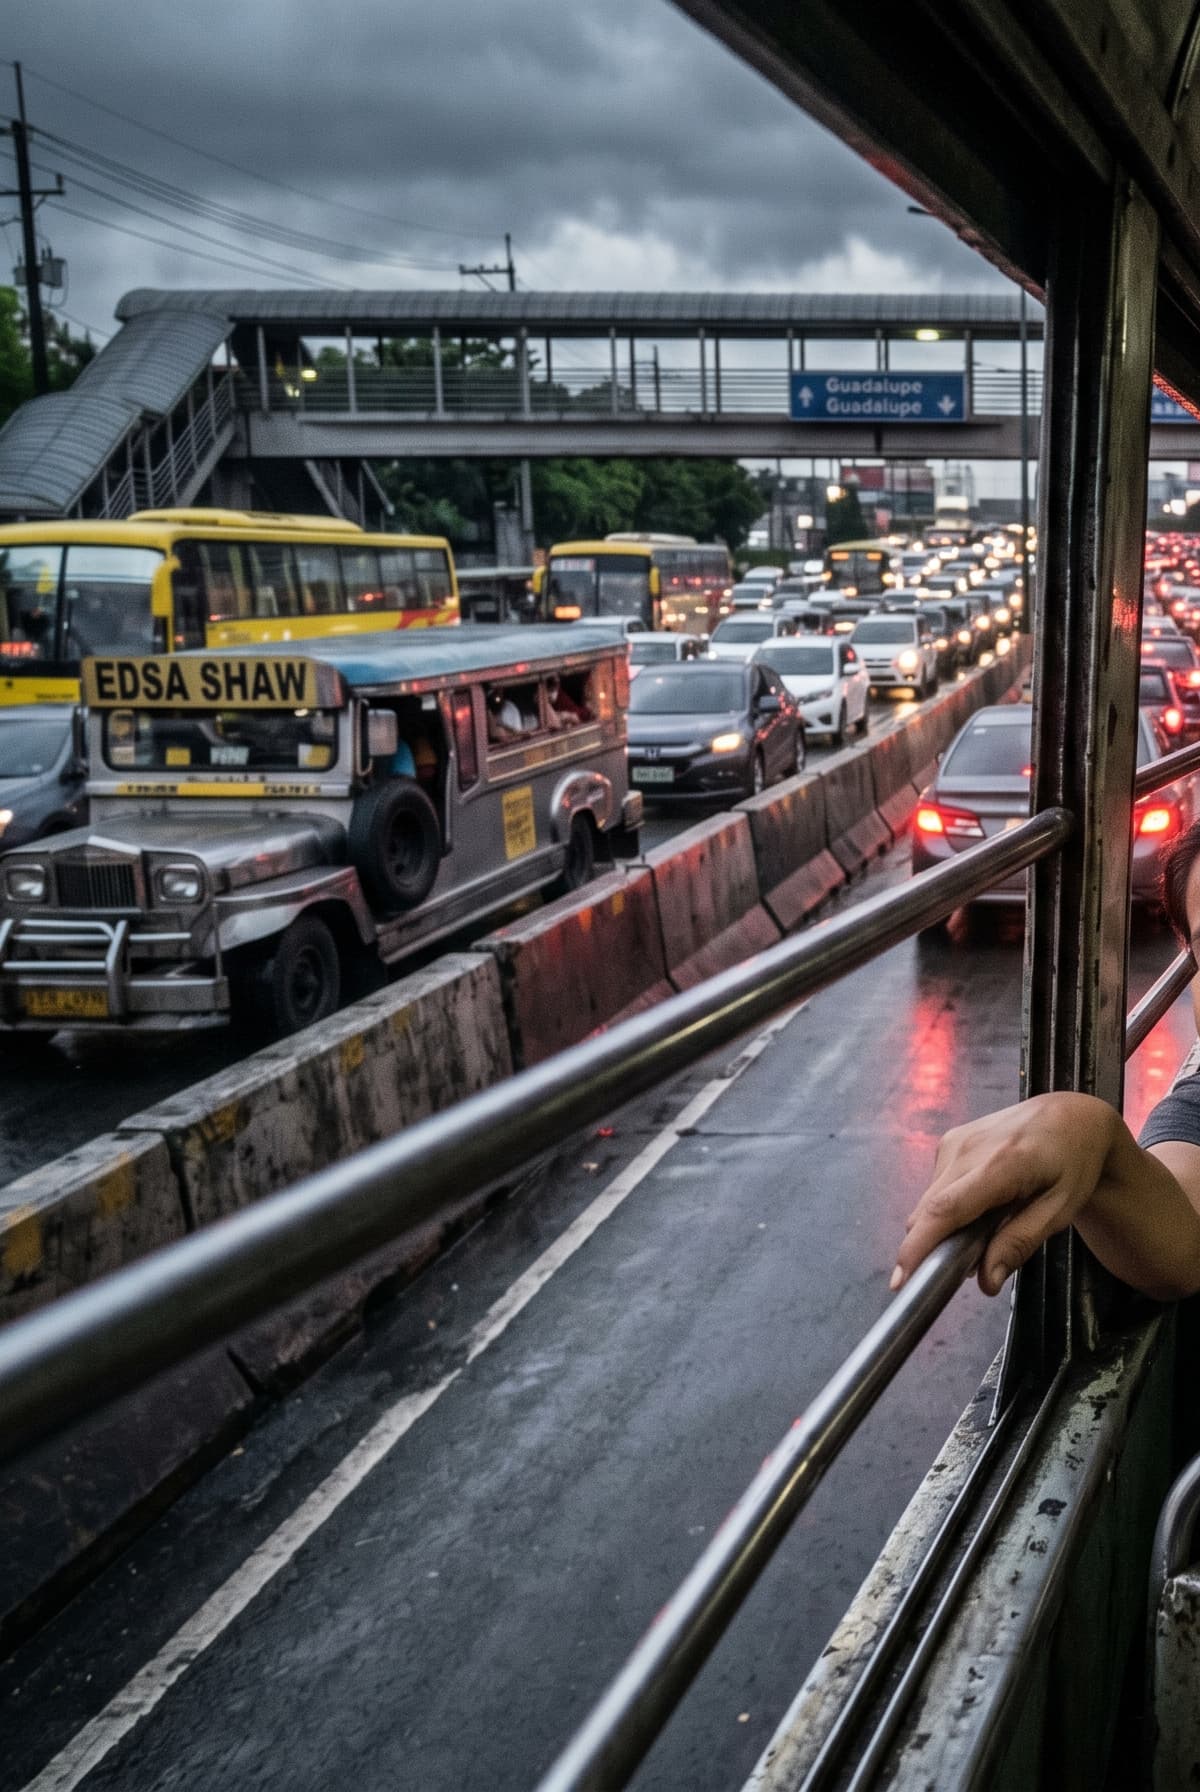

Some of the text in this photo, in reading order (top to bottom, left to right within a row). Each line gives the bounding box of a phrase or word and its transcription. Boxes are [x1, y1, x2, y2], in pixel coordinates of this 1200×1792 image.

[826, 377, 923, 396] Guadalupe
[826, 397, 923, 416] Guadalupe
[94, 661, 307, 700] EDSA SHAW
